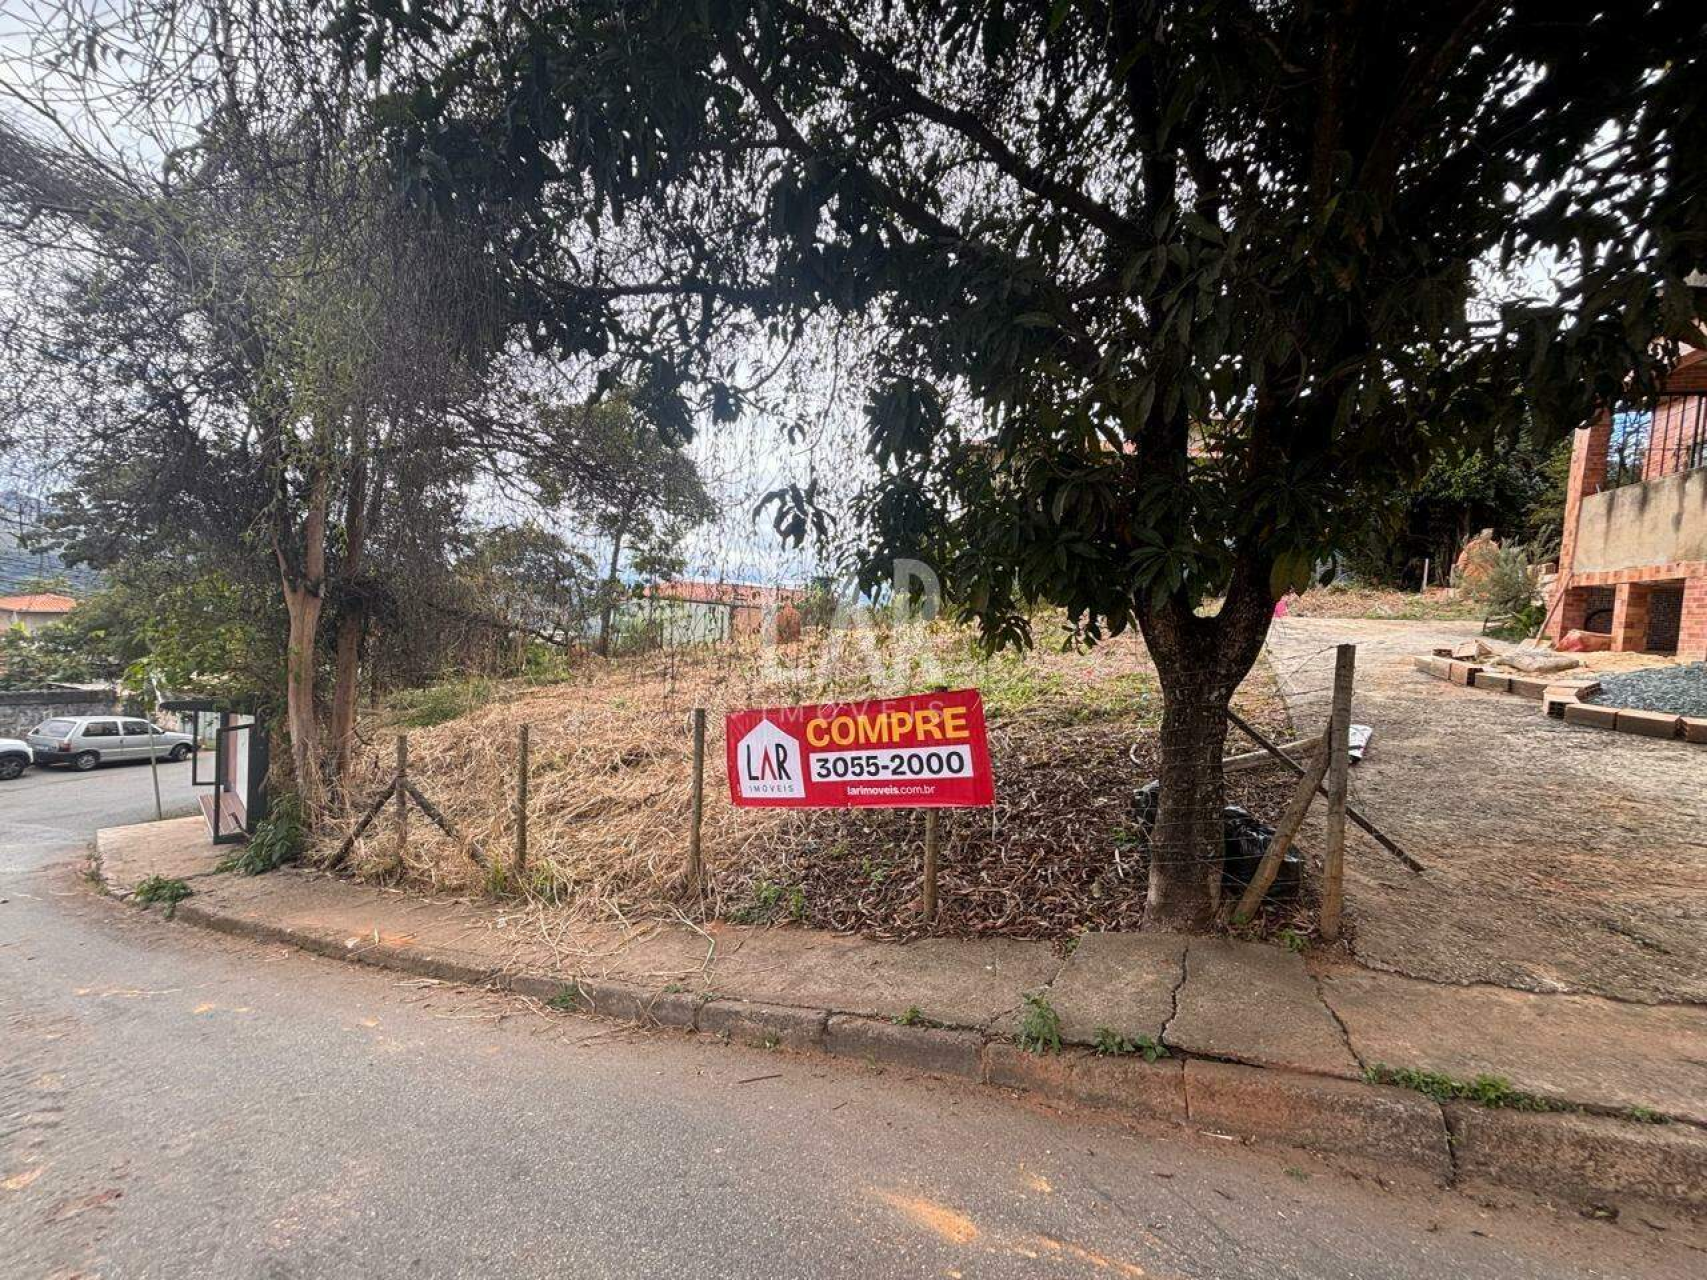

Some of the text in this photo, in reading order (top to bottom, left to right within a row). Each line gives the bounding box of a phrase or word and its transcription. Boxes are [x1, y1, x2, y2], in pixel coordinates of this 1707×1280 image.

[806, 706, 970, 747] COMPRE
[746, 743, 791, 780] LAR
[816, 751, 965, 778] 3055-2000
[847, 784, 936, 796] larimoveis.com.br
